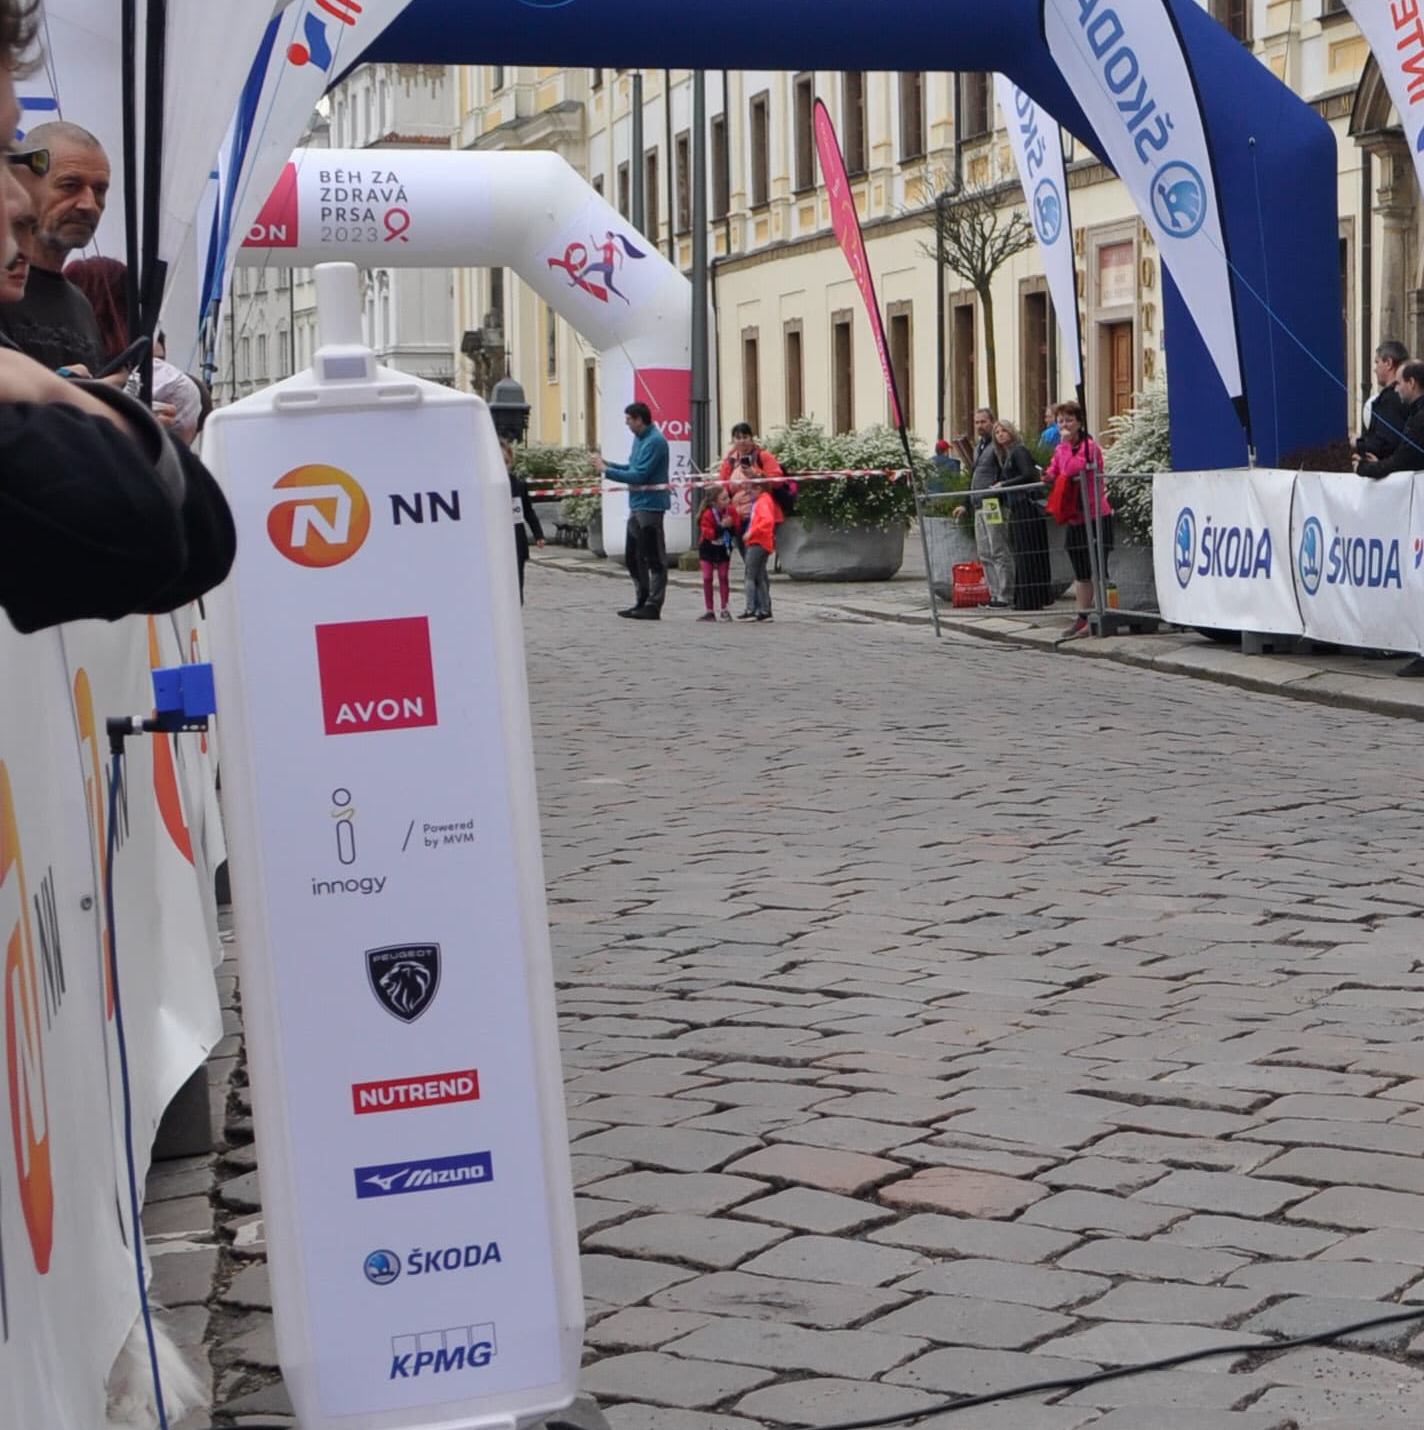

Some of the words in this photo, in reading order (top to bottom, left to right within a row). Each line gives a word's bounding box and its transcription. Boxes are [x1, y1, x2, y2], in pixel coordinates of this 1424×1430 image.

[372, 171, 399, 184] ZA
[320, 185, 408, 203] ZDRAVÁ
[321, 207, 376, 222] PRSA
[250, 224, 287, 241] ON
[321, 226, 379, 243] 2023
[389, 490, 462, 525] NN
[1198, 516, 1272, 579] ŠKODA
[1326, 526, 1402, 589] ŠKODA
[335, 697, 423, 725] AVON
[423, 818, 474, 833] Powered
[425, 837, 438, 849] by
[443, 832, 474, 844] MVM
[311, 875, 387, 896] innogy
[373, 949, 432, 963] PEUGEOT
[359, 1077, 474, 1107] NUTREND
[407, 1242, 501, 1275] ŠKODA
[390, 1341, 493, 1380] KPMG
